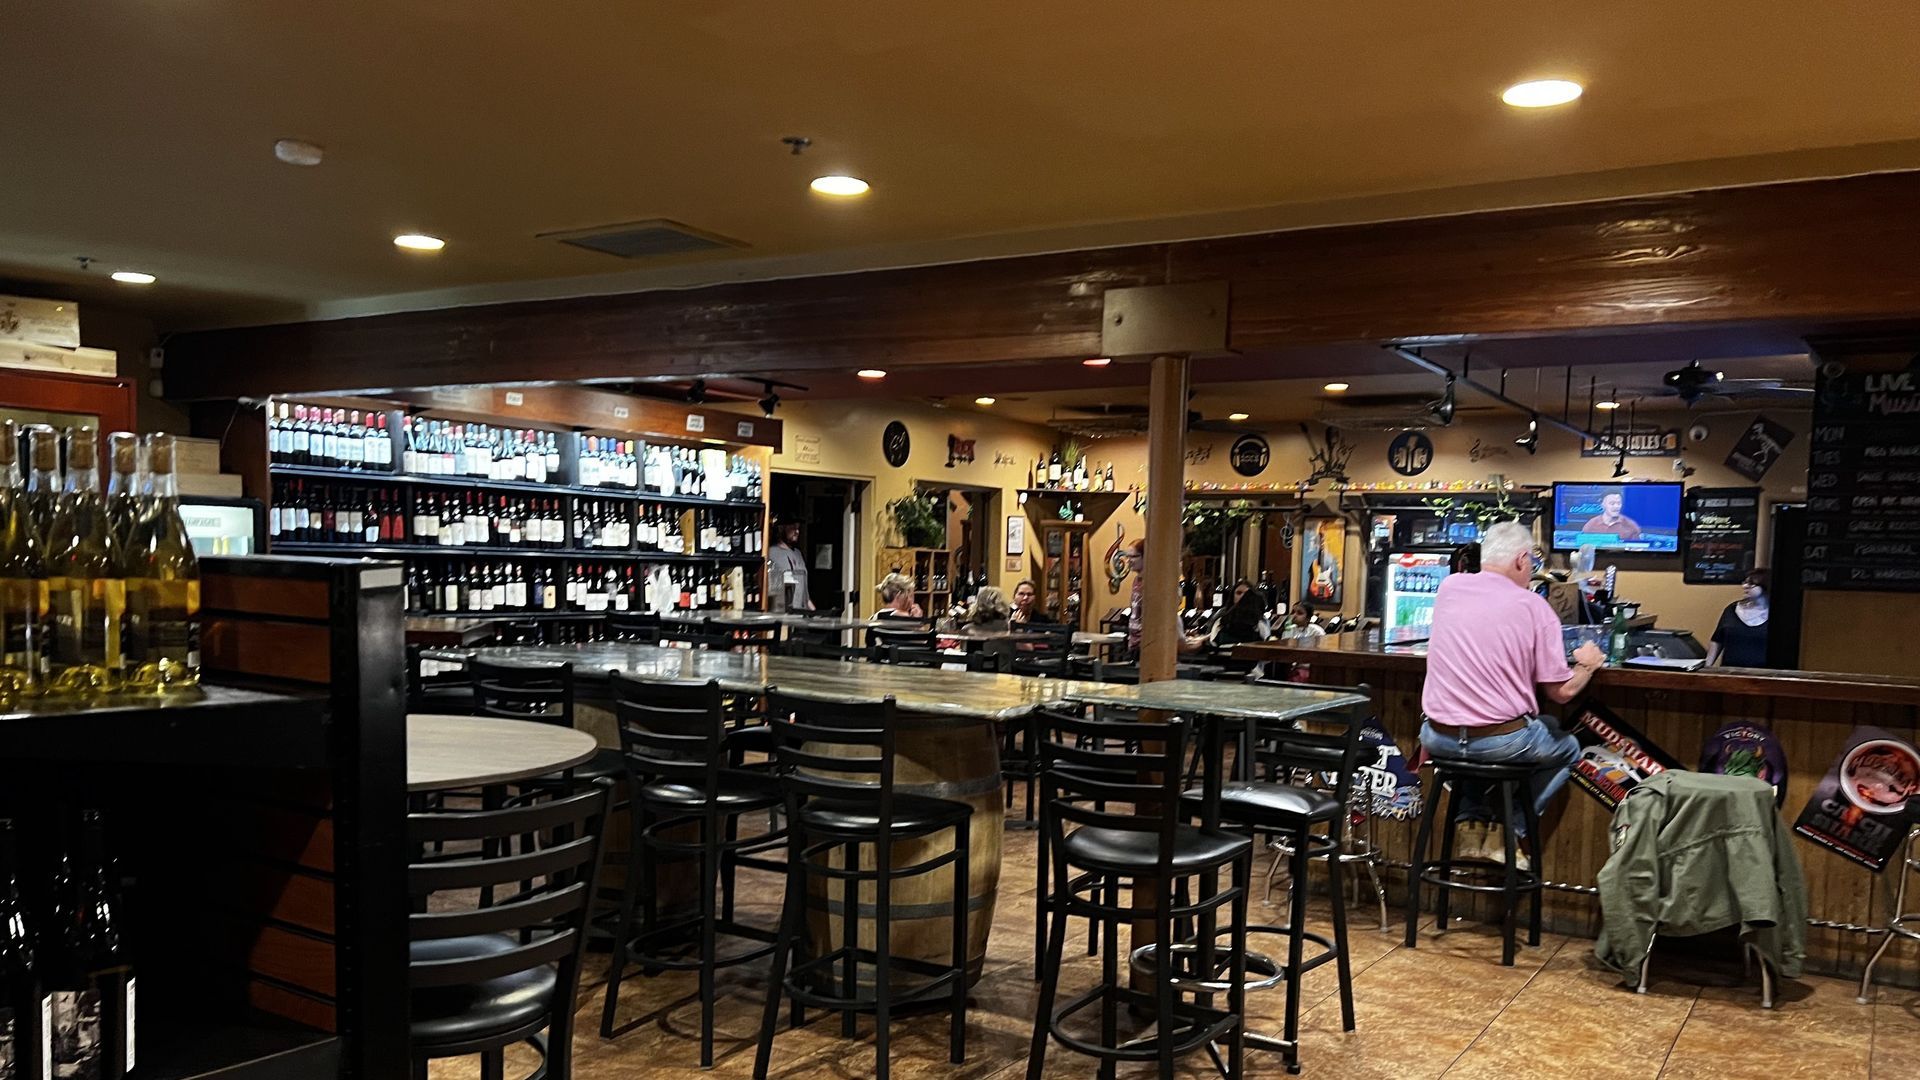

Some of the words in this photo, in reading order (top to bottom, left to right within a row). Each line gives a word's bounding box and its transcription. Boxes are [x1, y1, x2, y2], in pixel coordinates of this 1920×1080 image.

[1865, 373, 1916, 392] LIVE
[1814, 425, 1846, 442] MON
[1810, 471, 1839, 489] WED
[1802, 544, 1829, 561] SAT
[1578, 710, 1665, 777] MUDSHAR
[1722, 729, 1766, 743] VICTORY
